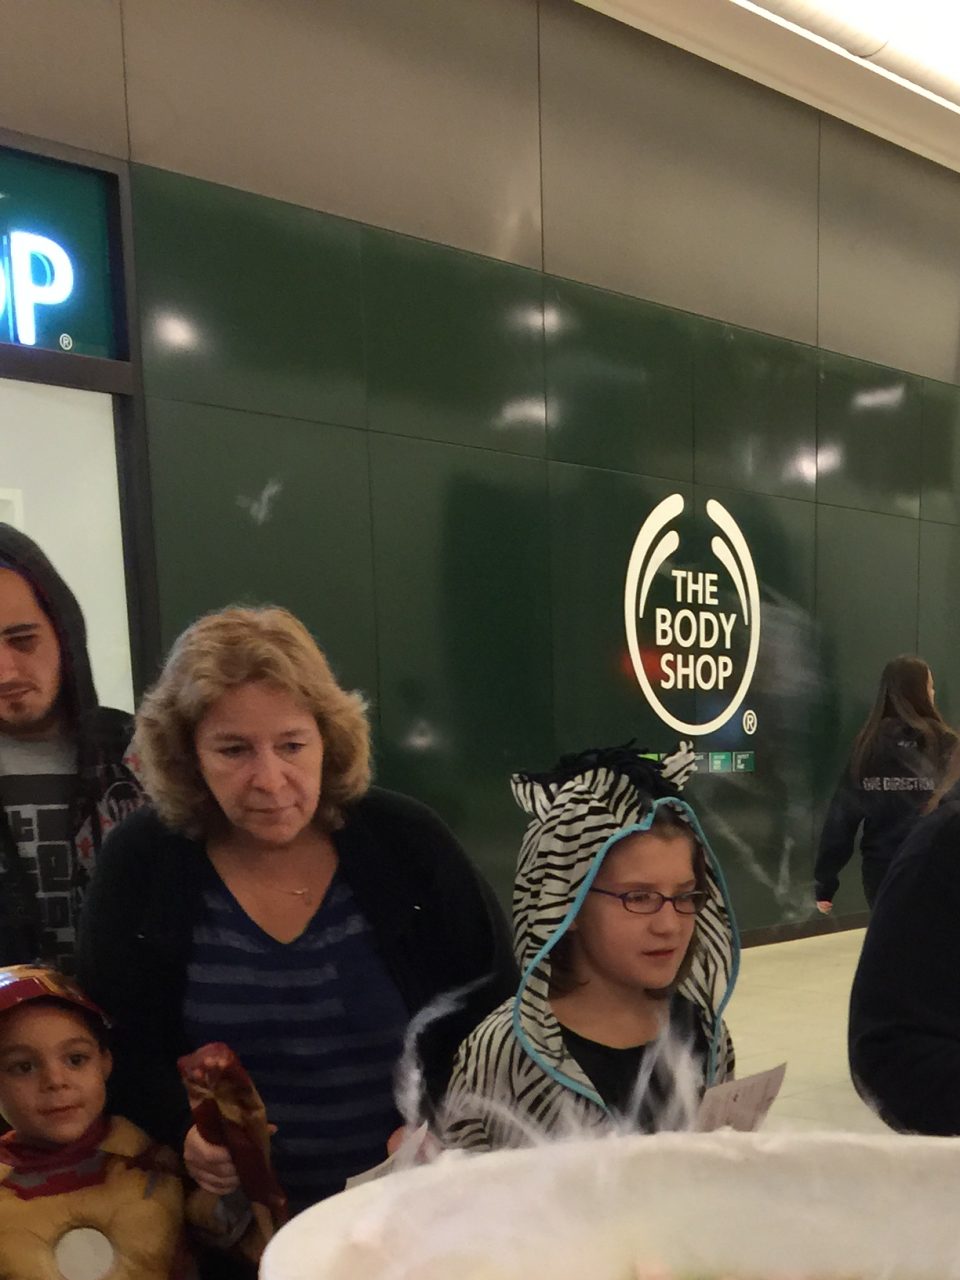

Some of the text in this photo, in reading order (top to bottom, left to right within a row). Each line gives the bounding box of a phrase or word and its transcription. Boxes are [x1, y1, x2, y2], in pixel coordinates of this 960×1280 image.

[672, 569, 719, 605] THE
[655, 607, 737, 649] BODY
[660, 652, 733, 690] SHOP
